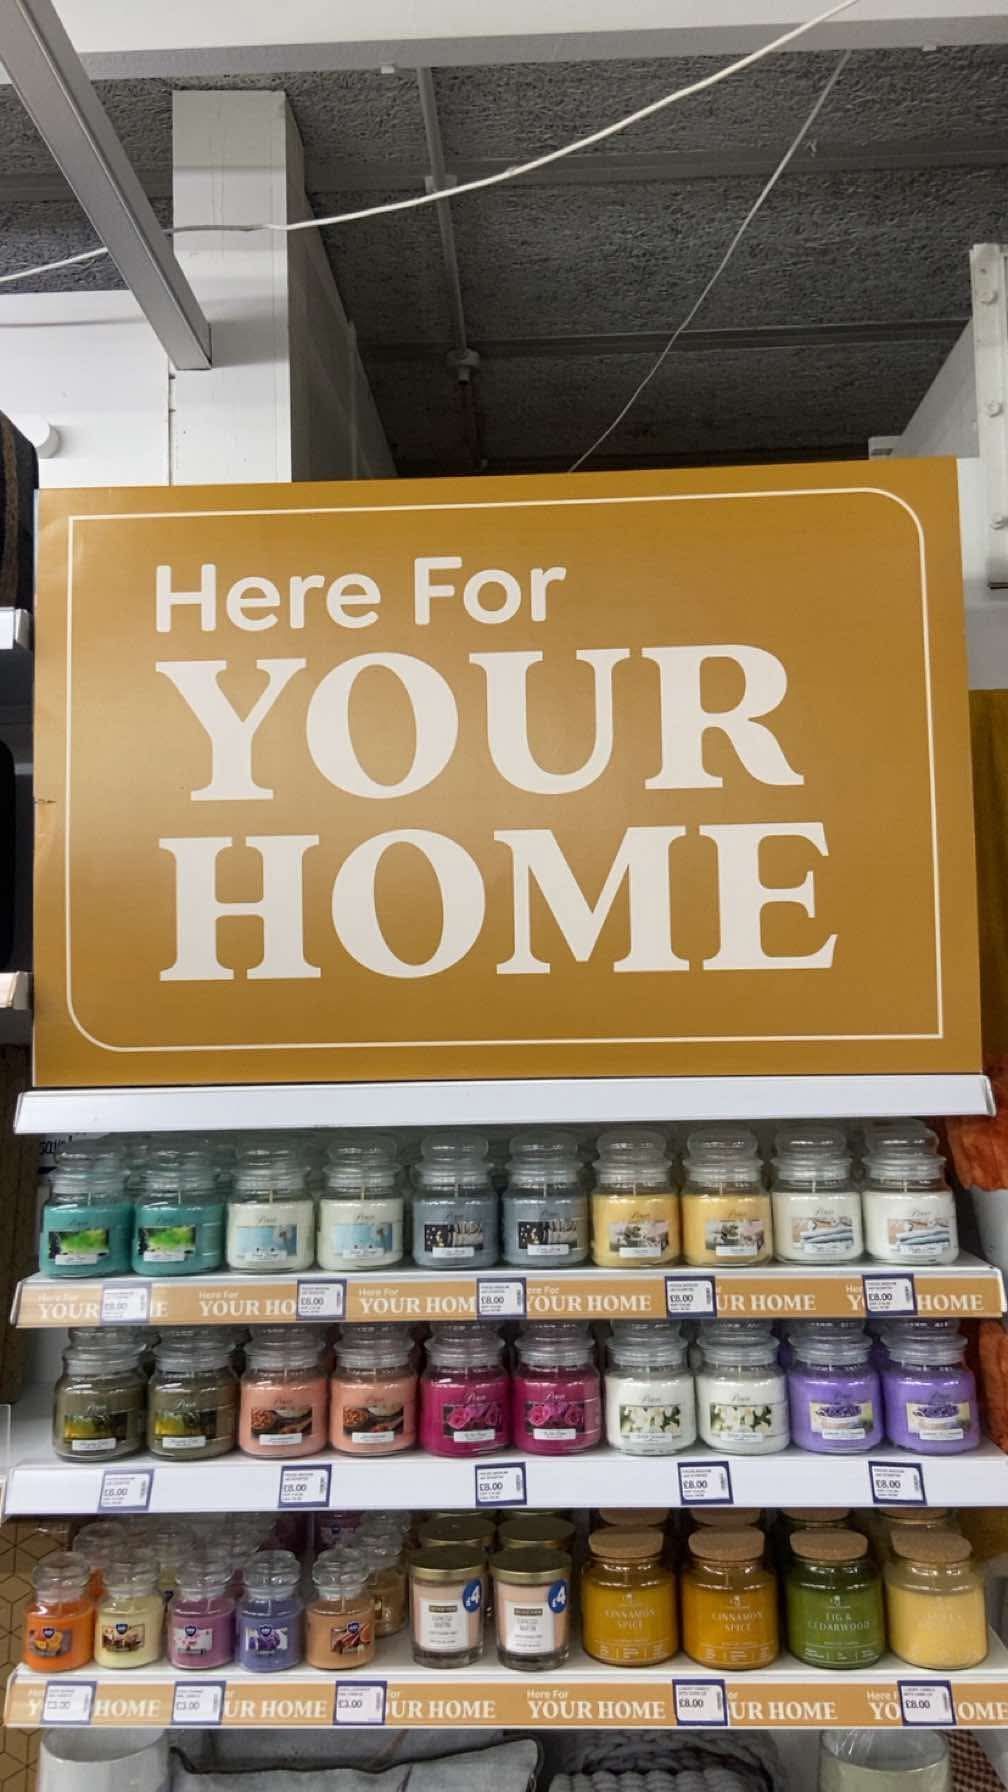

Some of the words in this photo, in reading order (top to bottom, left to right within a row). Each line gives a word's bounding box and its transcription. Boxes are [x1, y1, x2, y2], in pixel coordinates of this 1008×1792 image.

[156, 563, 380, 632] Here
[414, 556, 566, 627] For
[155, 644, 804, 801] YOUR
[159, 822, 838, 981] HOME
[200, 1291, 221, 1299] Here
[224, 1291, 239, 1299] For
[359, 1288, 381, 1297] Here
[383, 1288, 399, 1297] For
[527, 1287, 543, 1295] ere
[544, 1286, 559, 1295] For
[670, 1294, 693, 1303] £8.00
[868, 1292, 892, 1301] £8.00
[200, 1299, 260, 1316] YOUR
[265, 1299, 296, 1315] HO
[360, 1298, 421, 1314] YOUR
[426, 1296, 476, 1313] HOM
[481, 1296, 504, 1305] £8.00
[587, 1295, 652, 1312] HOME
[717, 1294, 745, 1311] UR
[751, 1294, 816, 1311] HOME
[917, 1294, 984, 1311] HOME
[39, 1303, 98, 1319] YOUR
[479, 1482, 503, 1492] £8.00
[683, 1479, 708, 1490] £8.00
[876, 1479, 901, 1490] £8.00
[527, 1689, 550, 1698] Here
[552, 1689, 568, 1699] For
[866, 1690, 891, 1700] Here
[94, 1699, 160, 1717] HOME
[225, 1700, 256, 1718] UR
[261, 1700, 327, 1718] HOME
[387, 1700, 426, 1718] UR
[429, 1700, 496, 1718] HOME
[528, 1701, 592, 1719] YOUR
[597, 1701, 665, 1719] HOME
[679, 1699, 704, 1708] £8.00
[730, 1701, 763, 1720] UR
[768, 1701, 838, 1720] HOME
[868, 1701, 899, 1720] YO
[906, 1699, 930, 1709] £8.00
[958, 1701, 1008, 1720] OME
